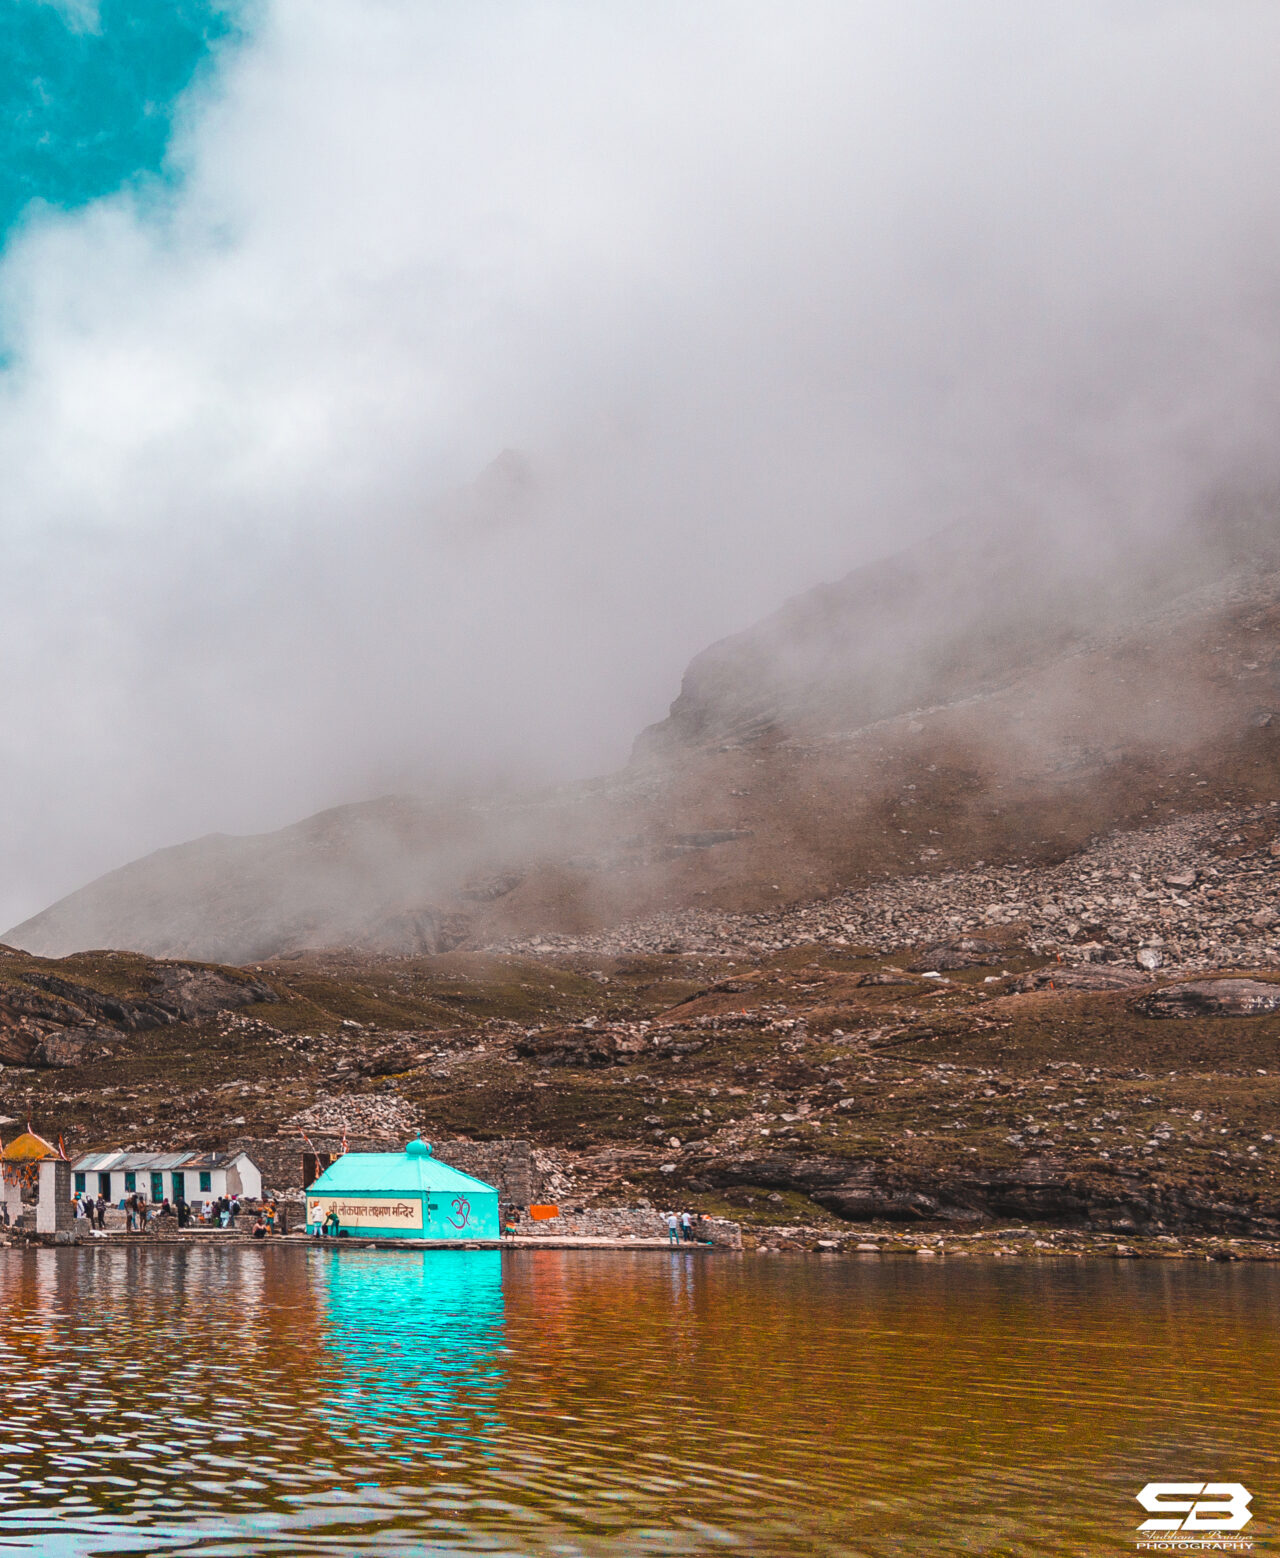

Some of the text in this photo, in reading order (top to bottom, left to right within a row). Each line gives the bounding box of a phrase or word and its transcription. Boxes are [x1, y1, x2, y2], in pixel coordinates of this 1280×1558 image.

[338, 1202, 367, 1217] लोकपाल
[368, 1205, 391, 1218] लक्ष्मण
[392, 1202, 414, 1218] मन्दिर
